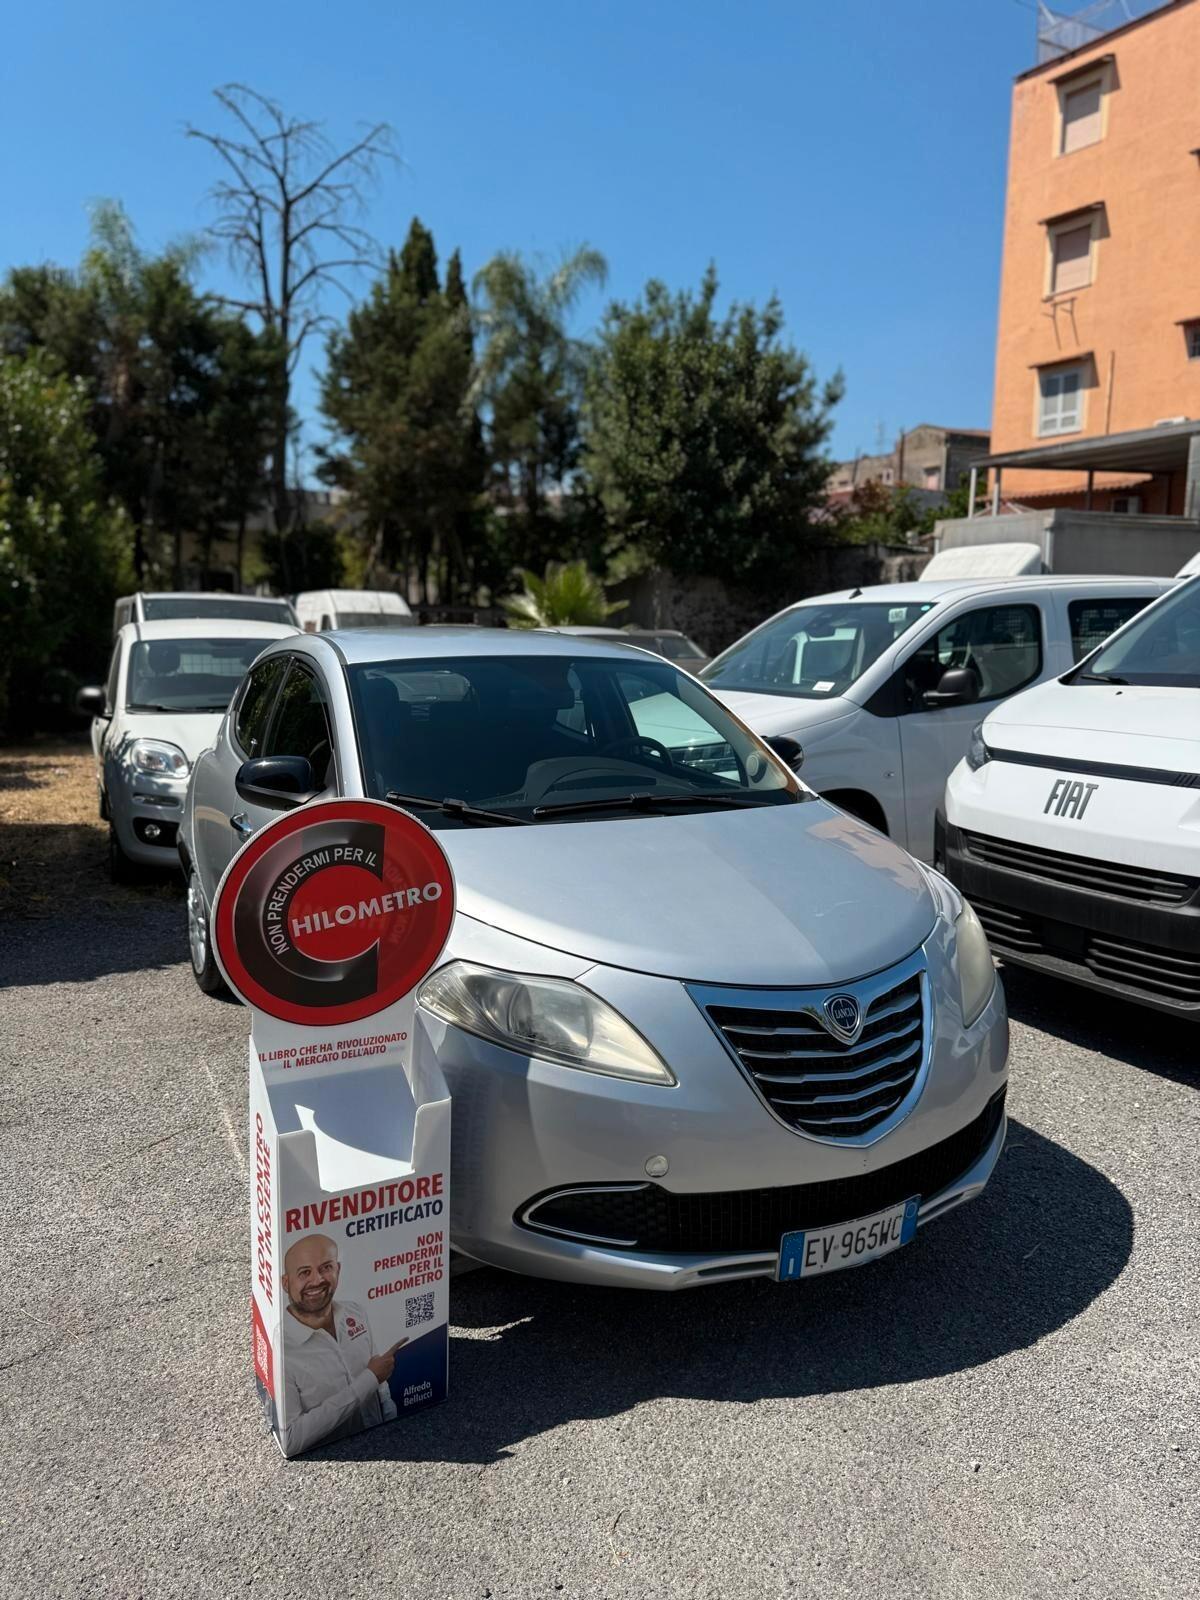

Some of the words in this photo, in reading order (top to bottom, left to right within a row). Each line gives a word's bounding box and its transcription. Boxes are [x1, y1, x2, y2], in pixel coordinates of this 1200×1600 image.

[1043, 779, 1099, 820] FIAT
[334, 847, 363, 862] PER
[365, 851, 377, 867] IL
[267, 850, 330, 920] PRENDERMI
[267, 924, 290, 955] NON
[269, 1049, 297, 1061] LIBRO
[300, 1044, 317, 1056] CHE
[319, 1043, 333, 1052] HA
[337, 1032, 408, 1049] RIVOLUZIONATO
[283, 1059, 292, 1069] IL
[296, 1053, 339, 1067] MERCATO
[342, 1045, 387, 1059] DELL'AUTO
[255, 1112, 264, 1223] CONTRO
[263, 1139, 273, 1257] INSIEME
[286, 1173, 443, 1233] RIVENDITORE
[346, 1199, 443, 1237] CERTIFICATO
[417, 1231, 443, 1247] NON
[257, 1226, 266, 1292] NON
[374, 1244, 443, 1272] PRENDERMI
[409, 1260, 431, 1275] PER
[433, 1257, 444, 1269] IL
[265, 1260, 273, 1307] MA
[368, 1269, 443, 1299] CHILOMETRO
[403, 1381, 431, 1397] Alfredo
[404, 1388, 433, 1407] Bellucci
